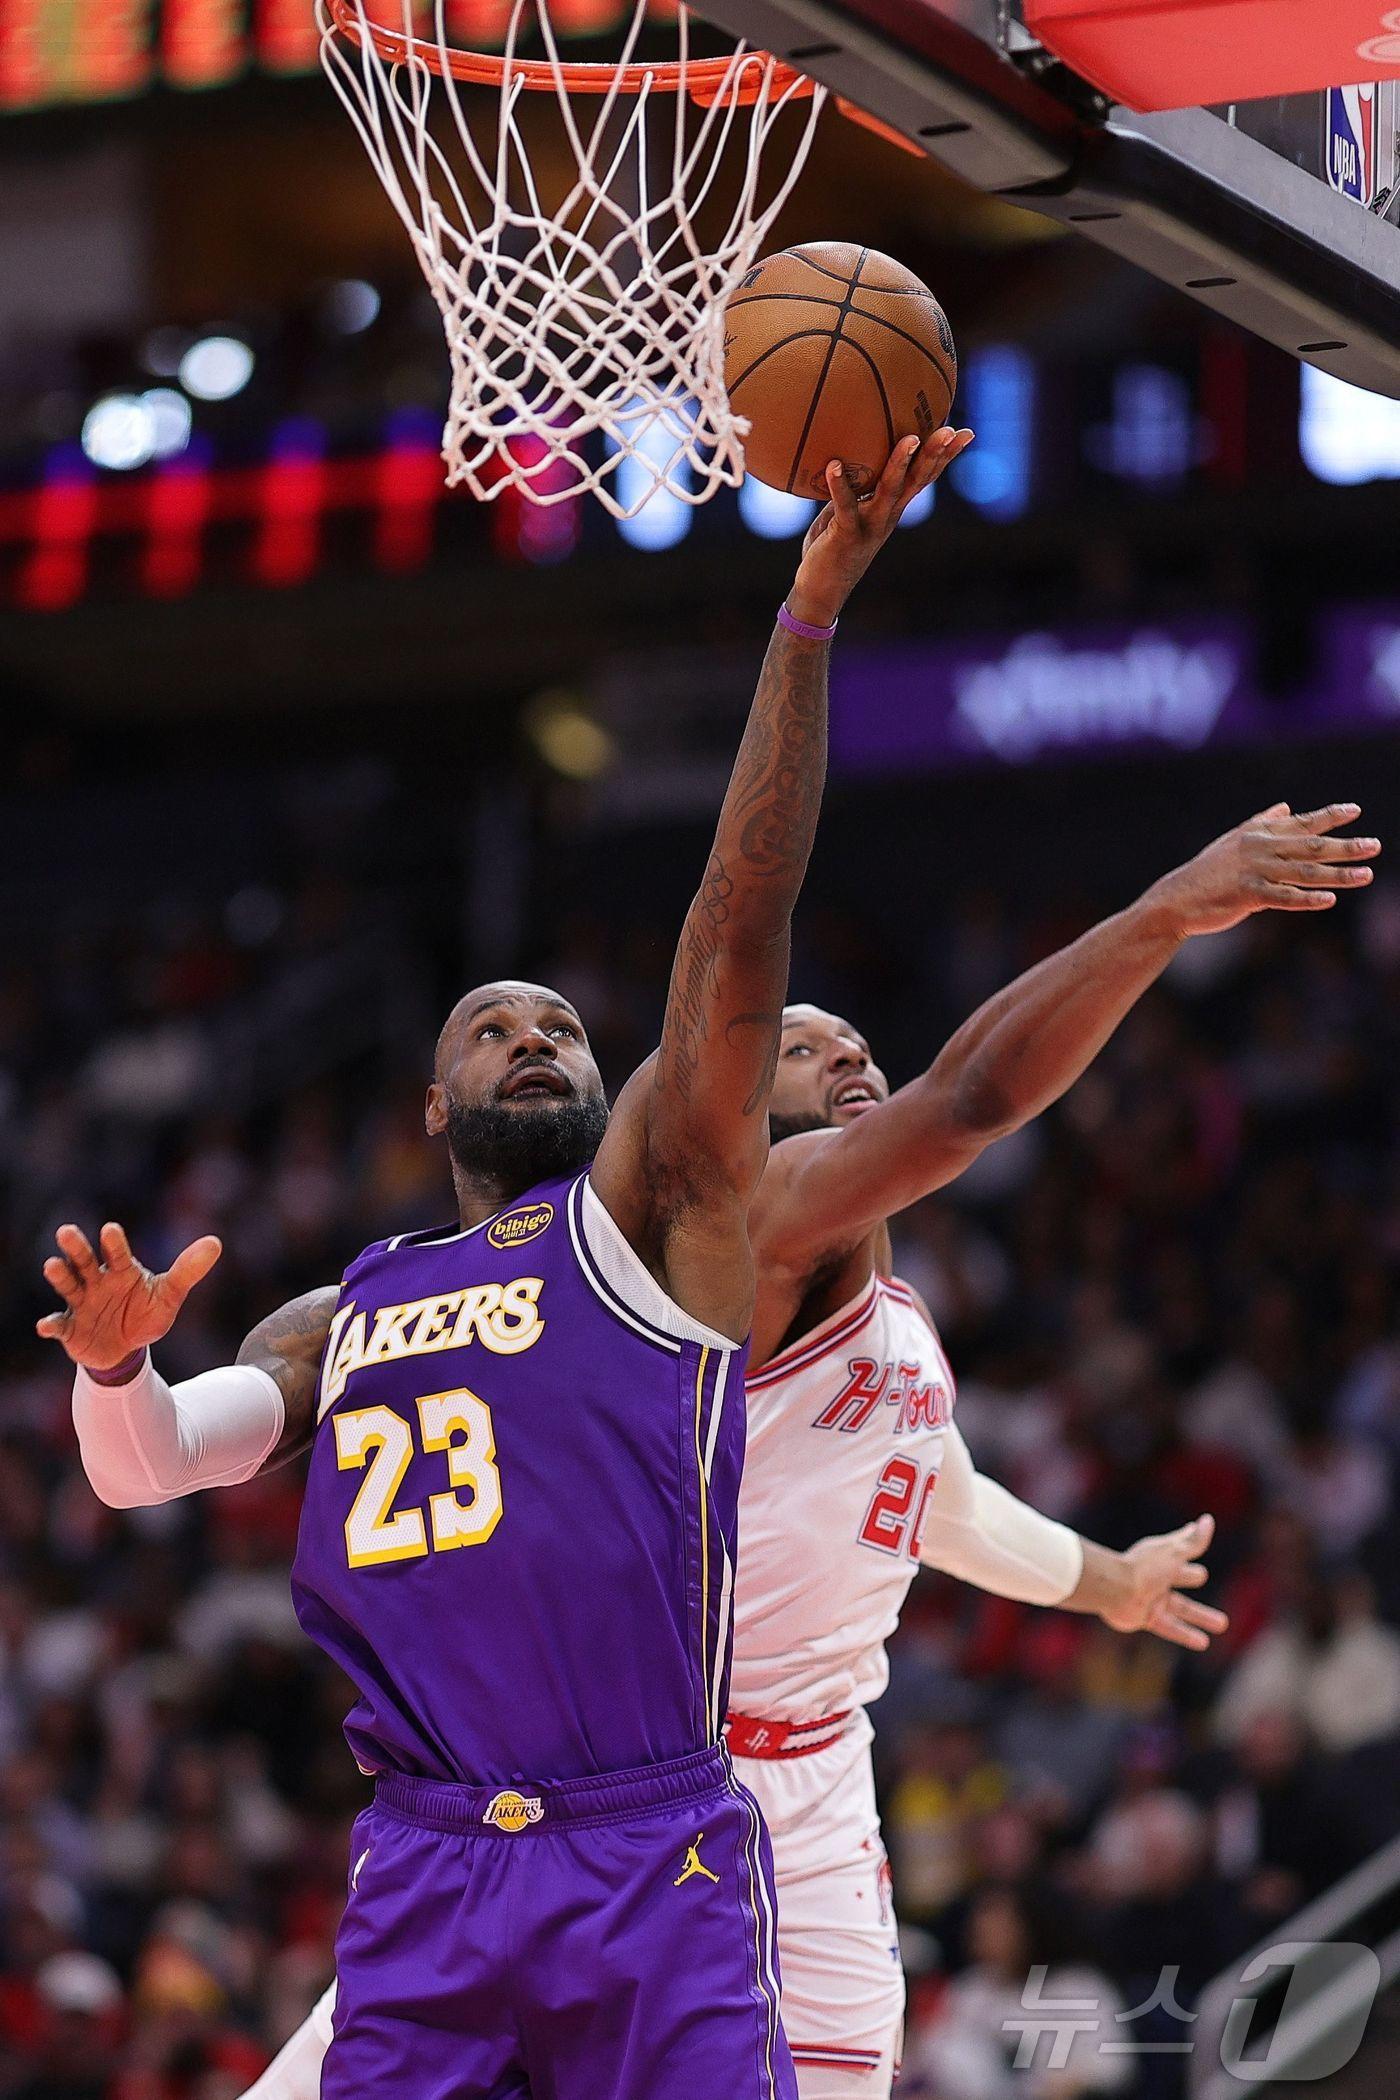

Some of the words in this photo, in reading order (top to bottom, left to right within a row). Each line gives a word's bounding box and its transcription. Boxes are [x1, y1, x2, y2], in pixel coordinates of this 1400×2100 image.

[1334, 133, 1357, 186] NBA
[494, 1212, 550, 1236] bibigo
[317, 1276, 546, 1427] LAKERS
[332, 1386, 504, 1569] 23
[484, 1801, 544, 1822] LAKERS
